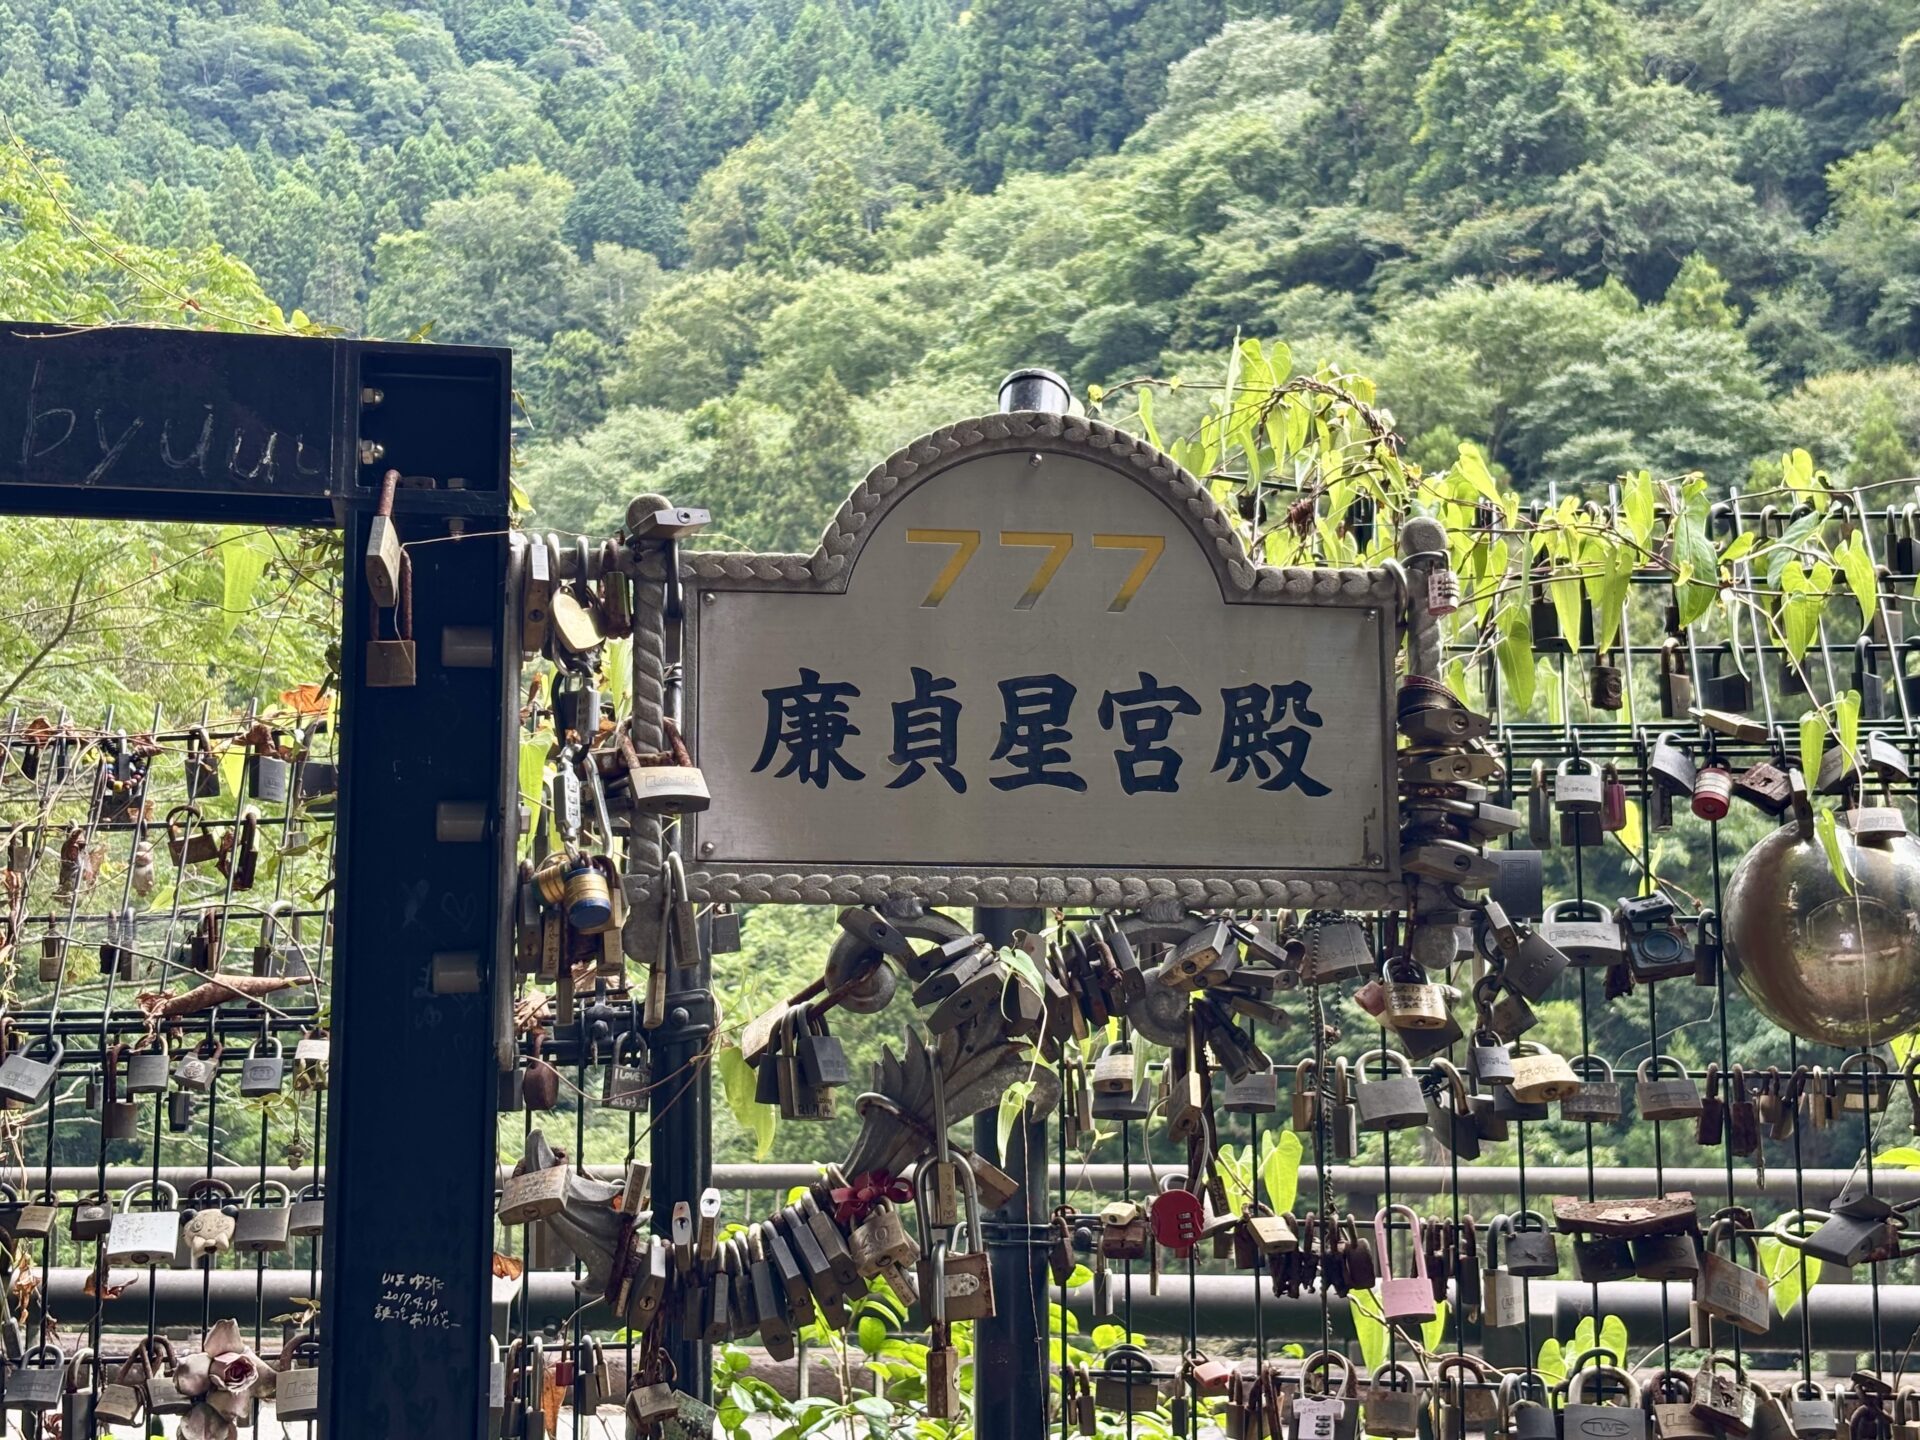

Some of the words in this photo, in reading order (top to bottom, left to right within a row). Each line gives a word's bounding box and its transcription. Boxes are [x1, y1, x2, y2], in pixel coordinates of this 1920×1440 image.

[906, 529, 1166, 613] 777
[750, 666, 1333, 798] 廉貞星宮殿
[382, 1290, 438, 1313] 2017.4.19
[1587, 1421, 1627, 1435] TWE
